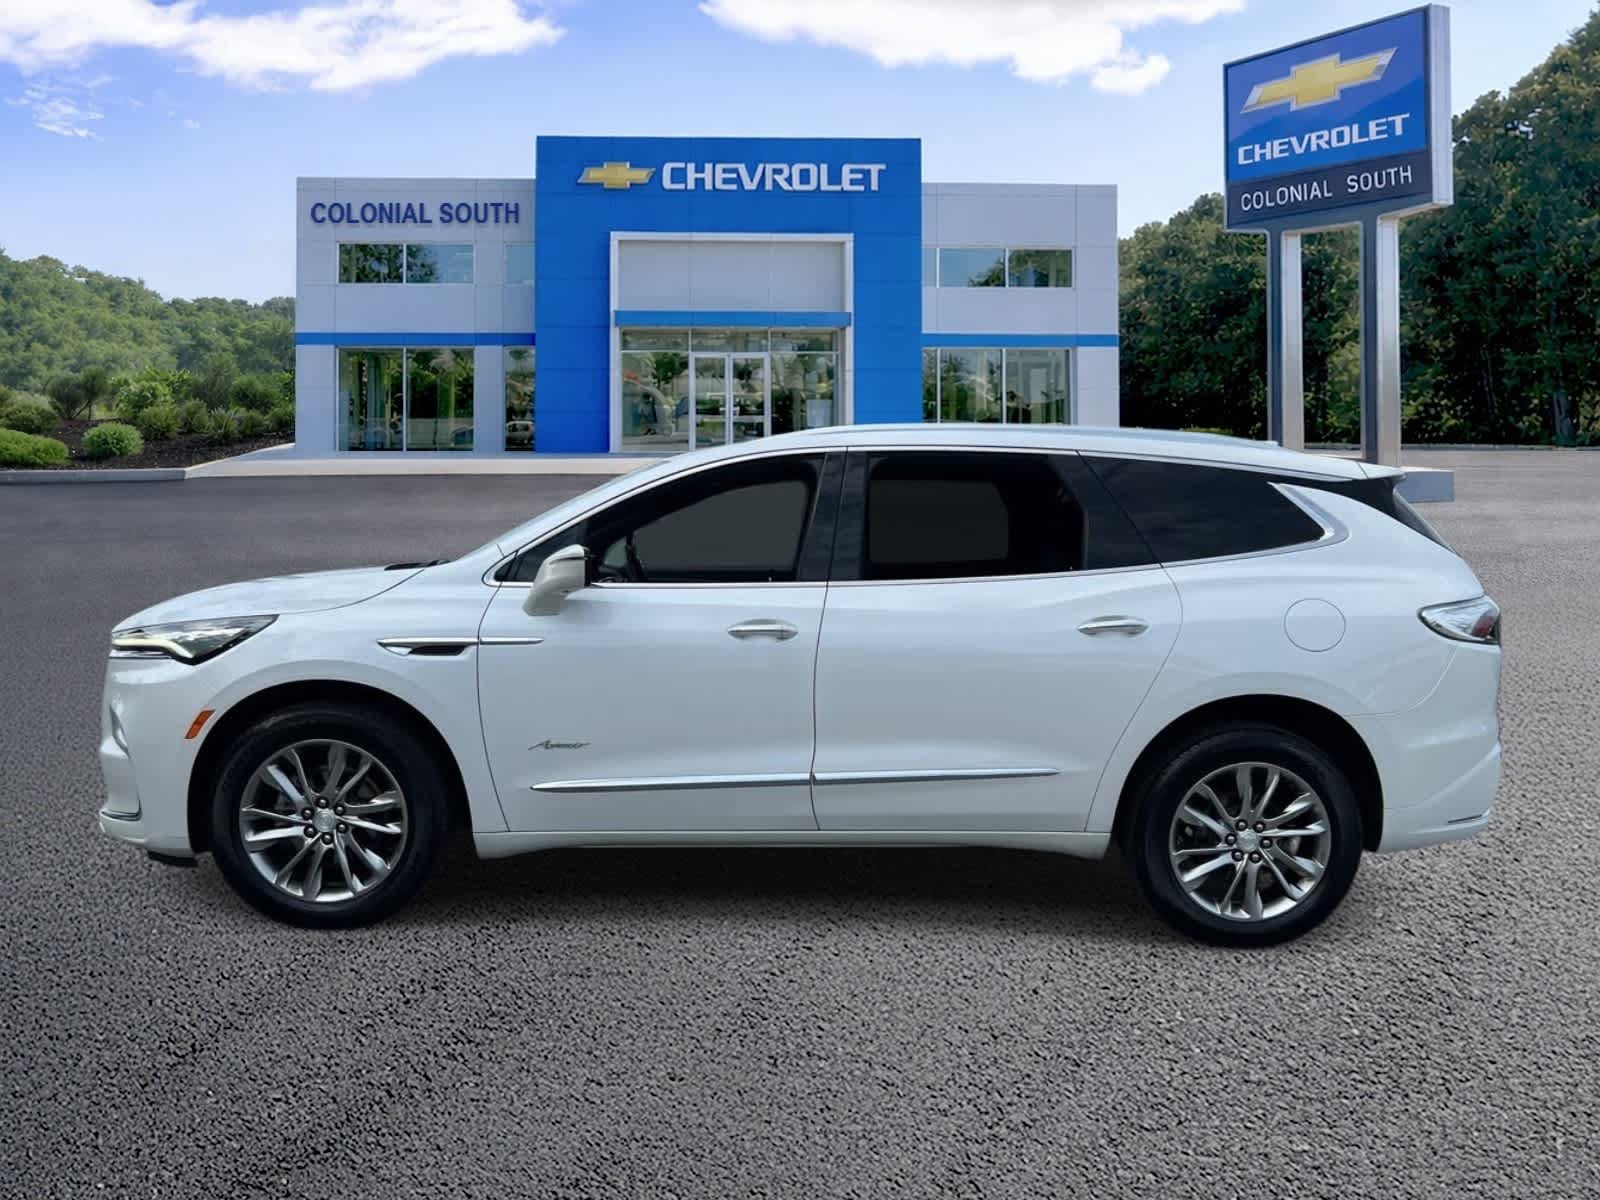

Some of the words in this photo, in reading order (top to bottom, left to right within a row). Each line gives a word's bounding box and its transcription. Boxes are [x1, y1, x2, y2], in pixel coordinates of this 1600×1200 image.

[1237, 113, 1410, 165] CHEVROLET
[661, 162, 886, 192] CHEVROLET
[1240, 180, 1333, 211] COLONIAL
[1346, 165, 1412, 194] SOUTH
[310, 202, 433, 225] COLONIAL
[439, 202, 520, 225] SOUTH
